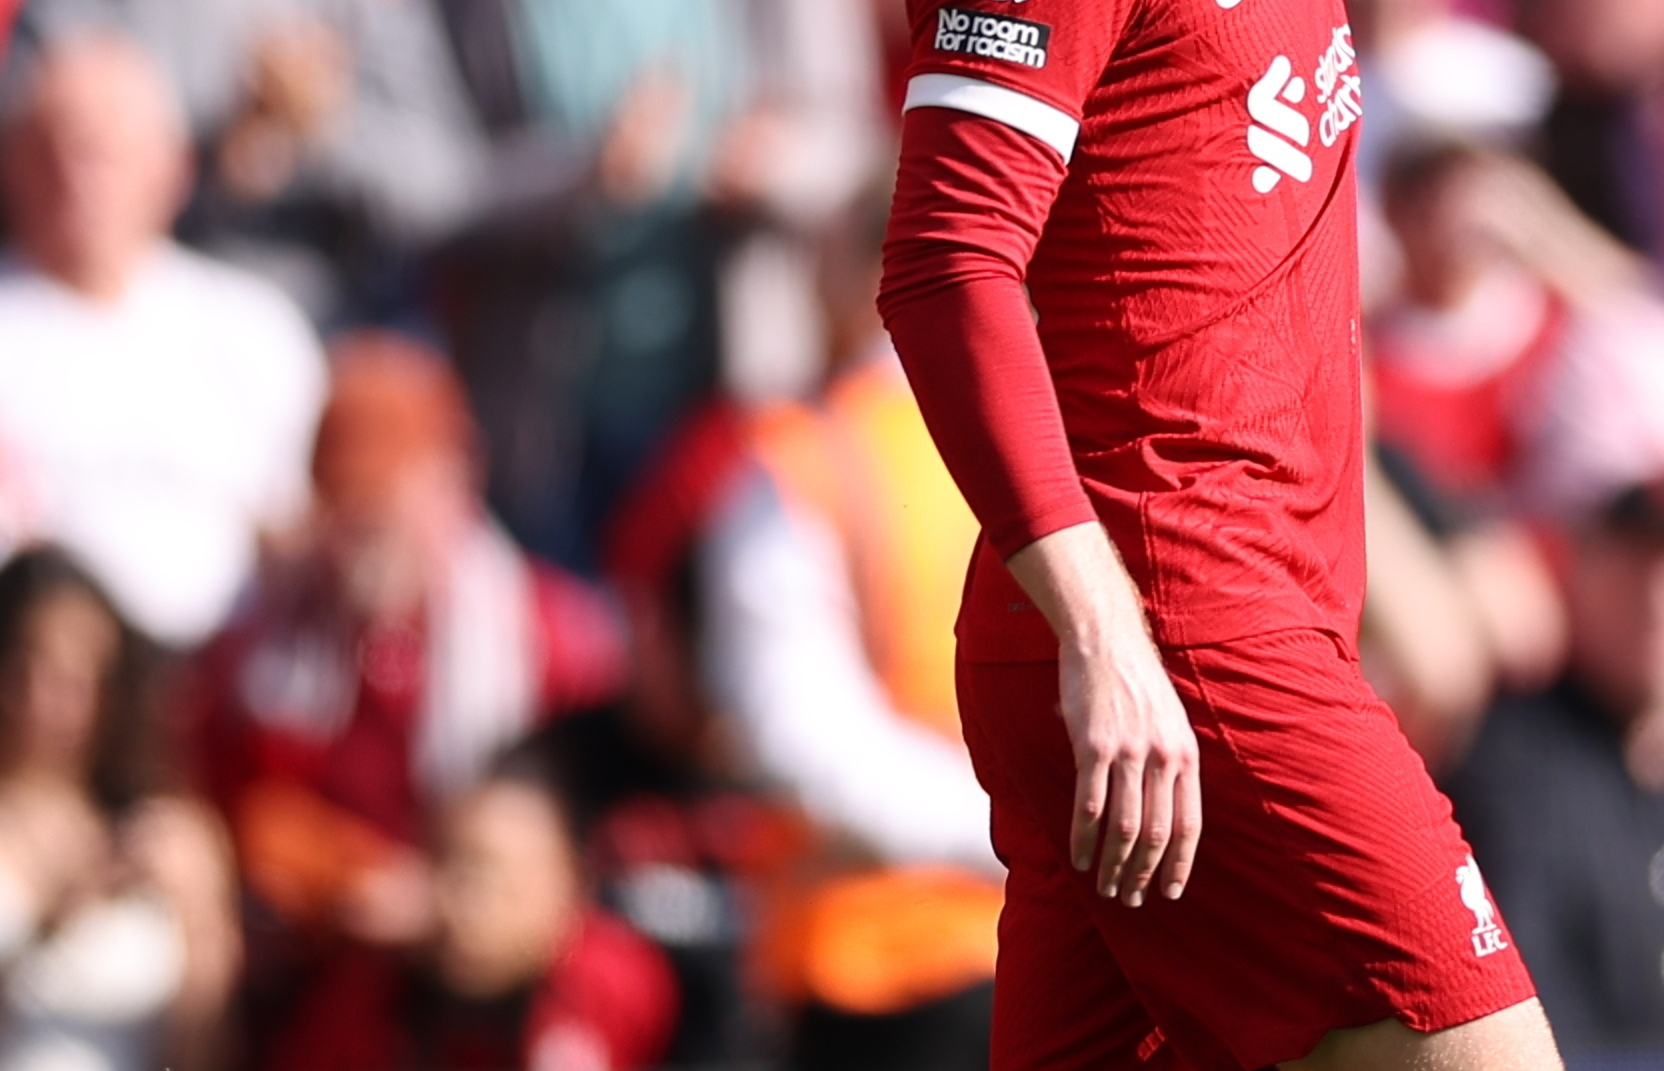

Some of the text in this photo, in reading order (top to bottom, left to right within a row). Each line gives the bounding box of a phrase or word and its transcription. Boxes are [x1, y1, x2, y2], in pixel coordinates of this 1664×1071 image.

[938, 8, 1040, 46] No room
[934, 28, 1046, 68] for racism
